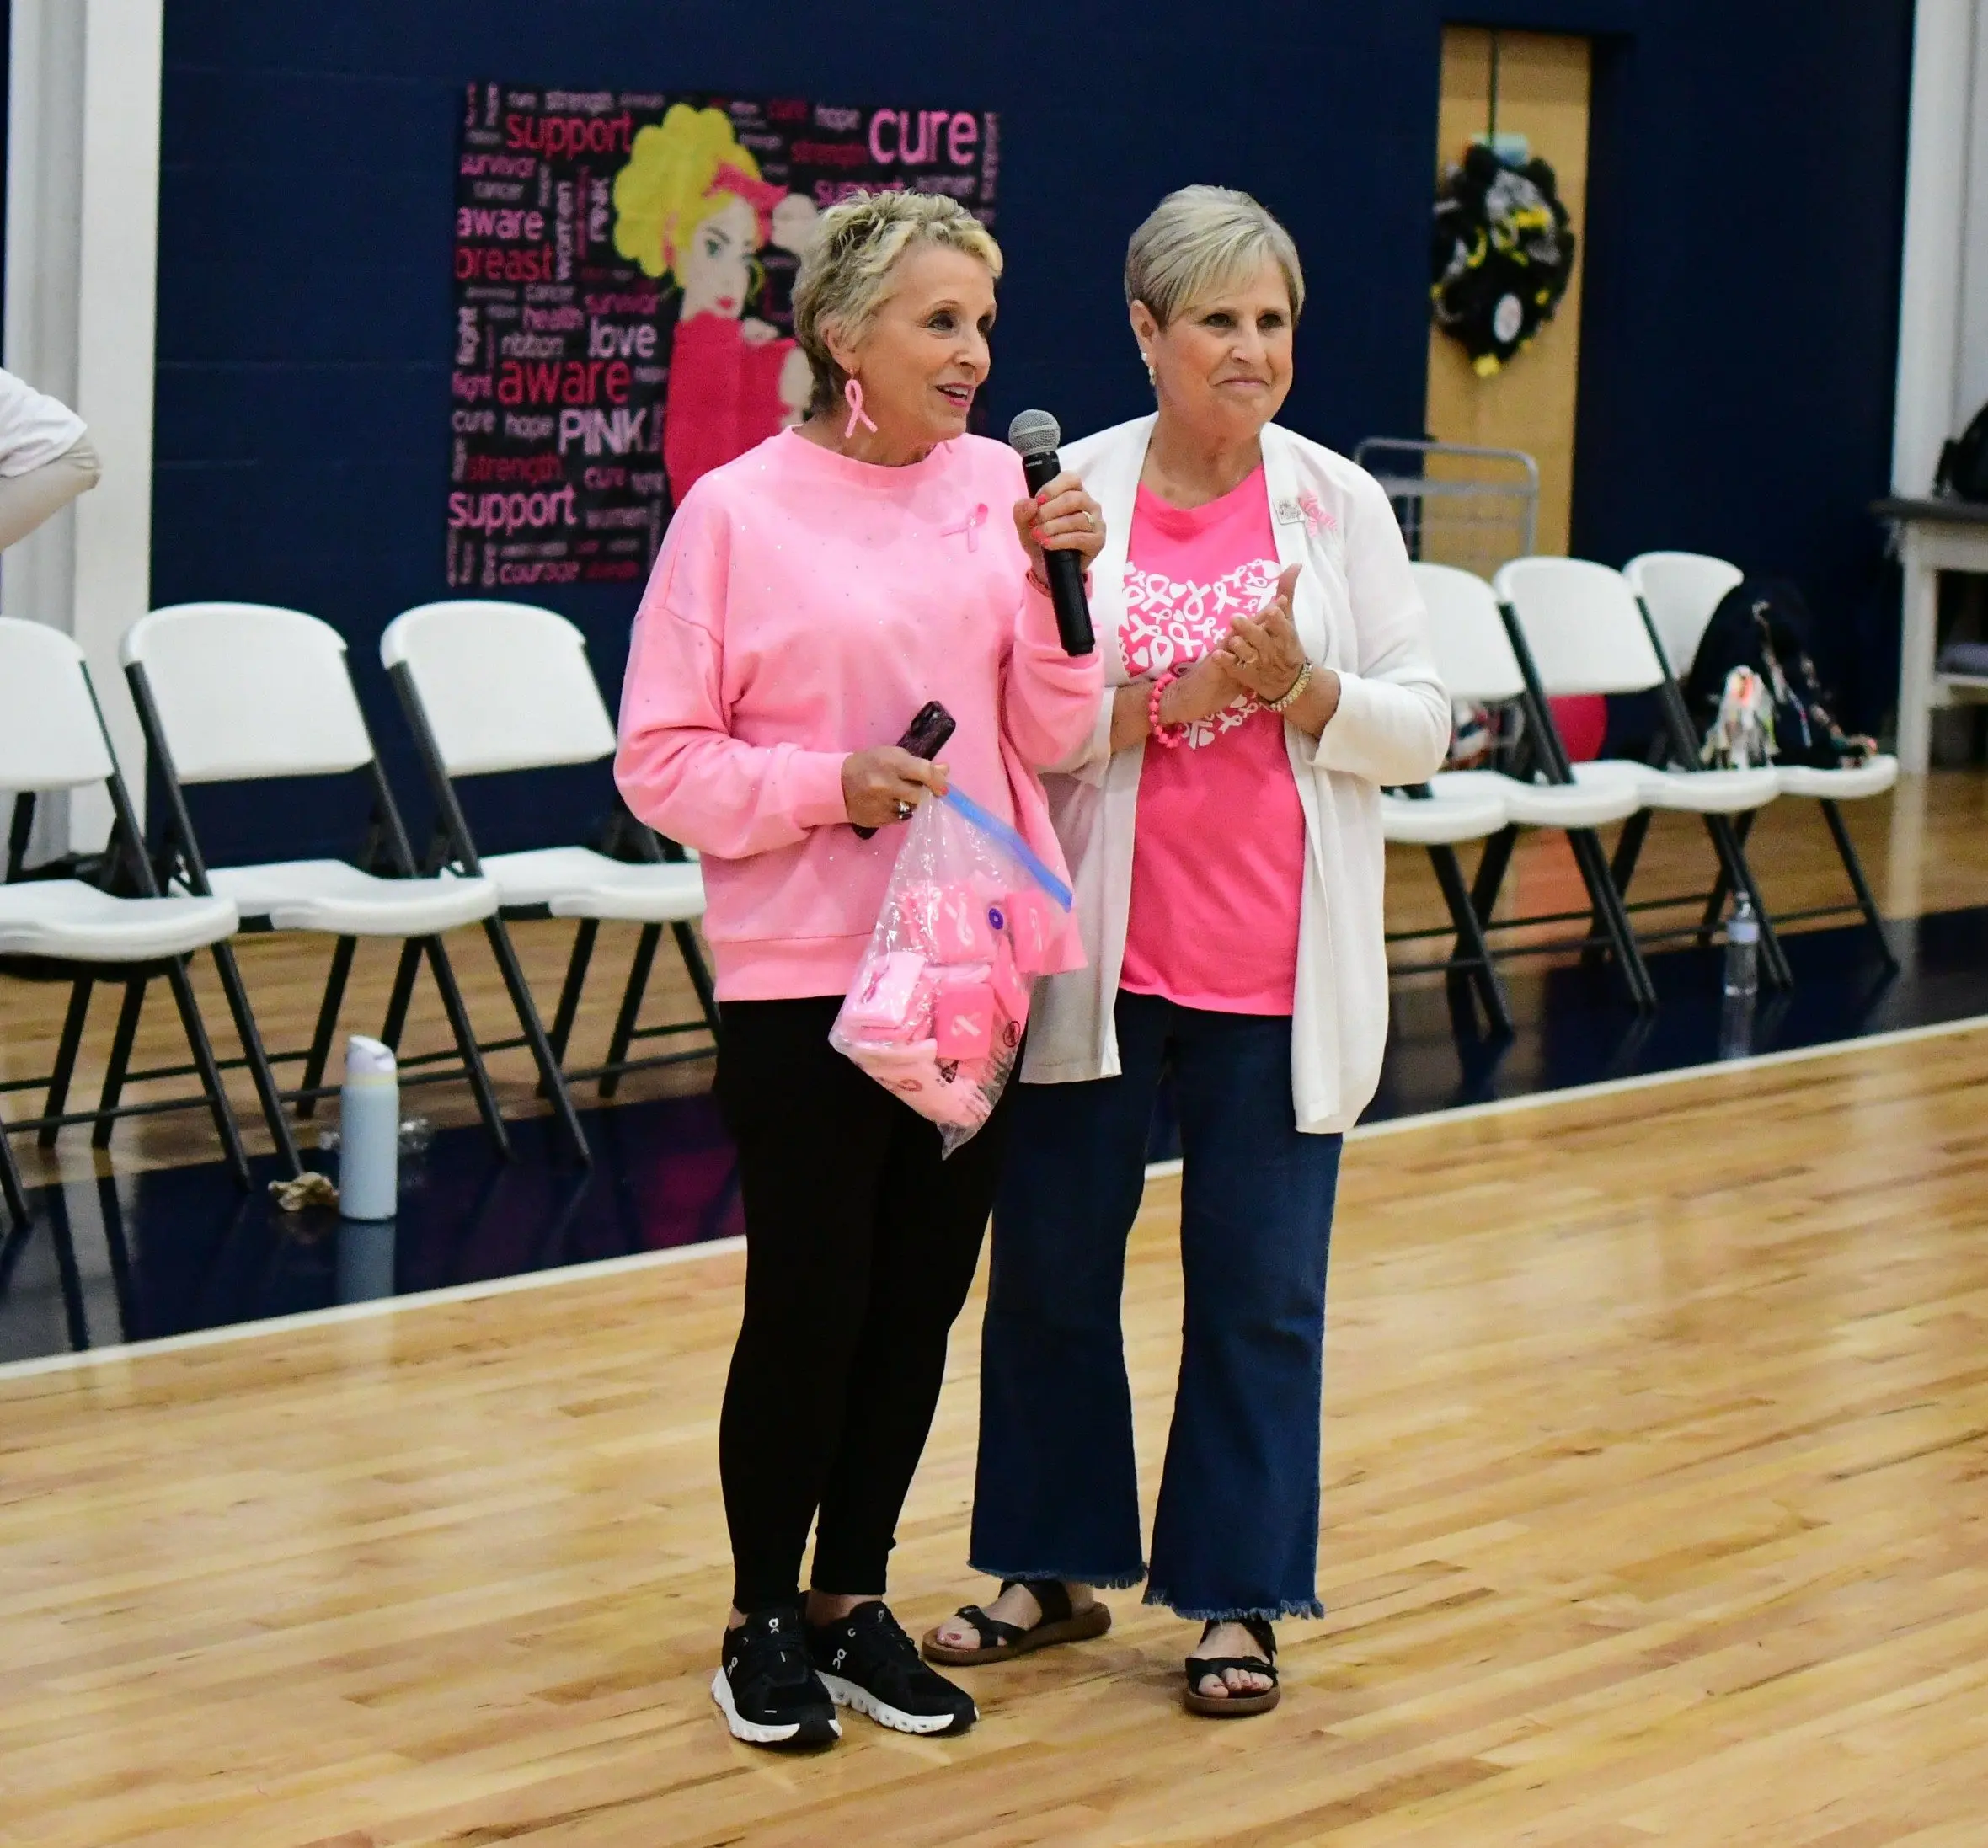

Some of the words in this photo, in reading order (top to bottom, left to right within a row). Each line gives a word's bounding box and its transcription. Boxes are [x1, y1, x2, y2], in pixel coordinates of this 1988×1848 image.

[505, 110, 633, 160] support
[868, 108, 978, 165] cure
[461, 155, 537, 179] survivor
[457, 207, 545, 240] aware
[589, 316, 657, 358] love
[497, 360, 631, 406] aware
[452, 410, 496, 433] cure
[505, 411, 554, 440] hope
[558, 408, 647, 457] PINK
[469, 453, 563, 487] strength
[583, 466, 625, 490] cure
[447, 483, 578, 537] support
